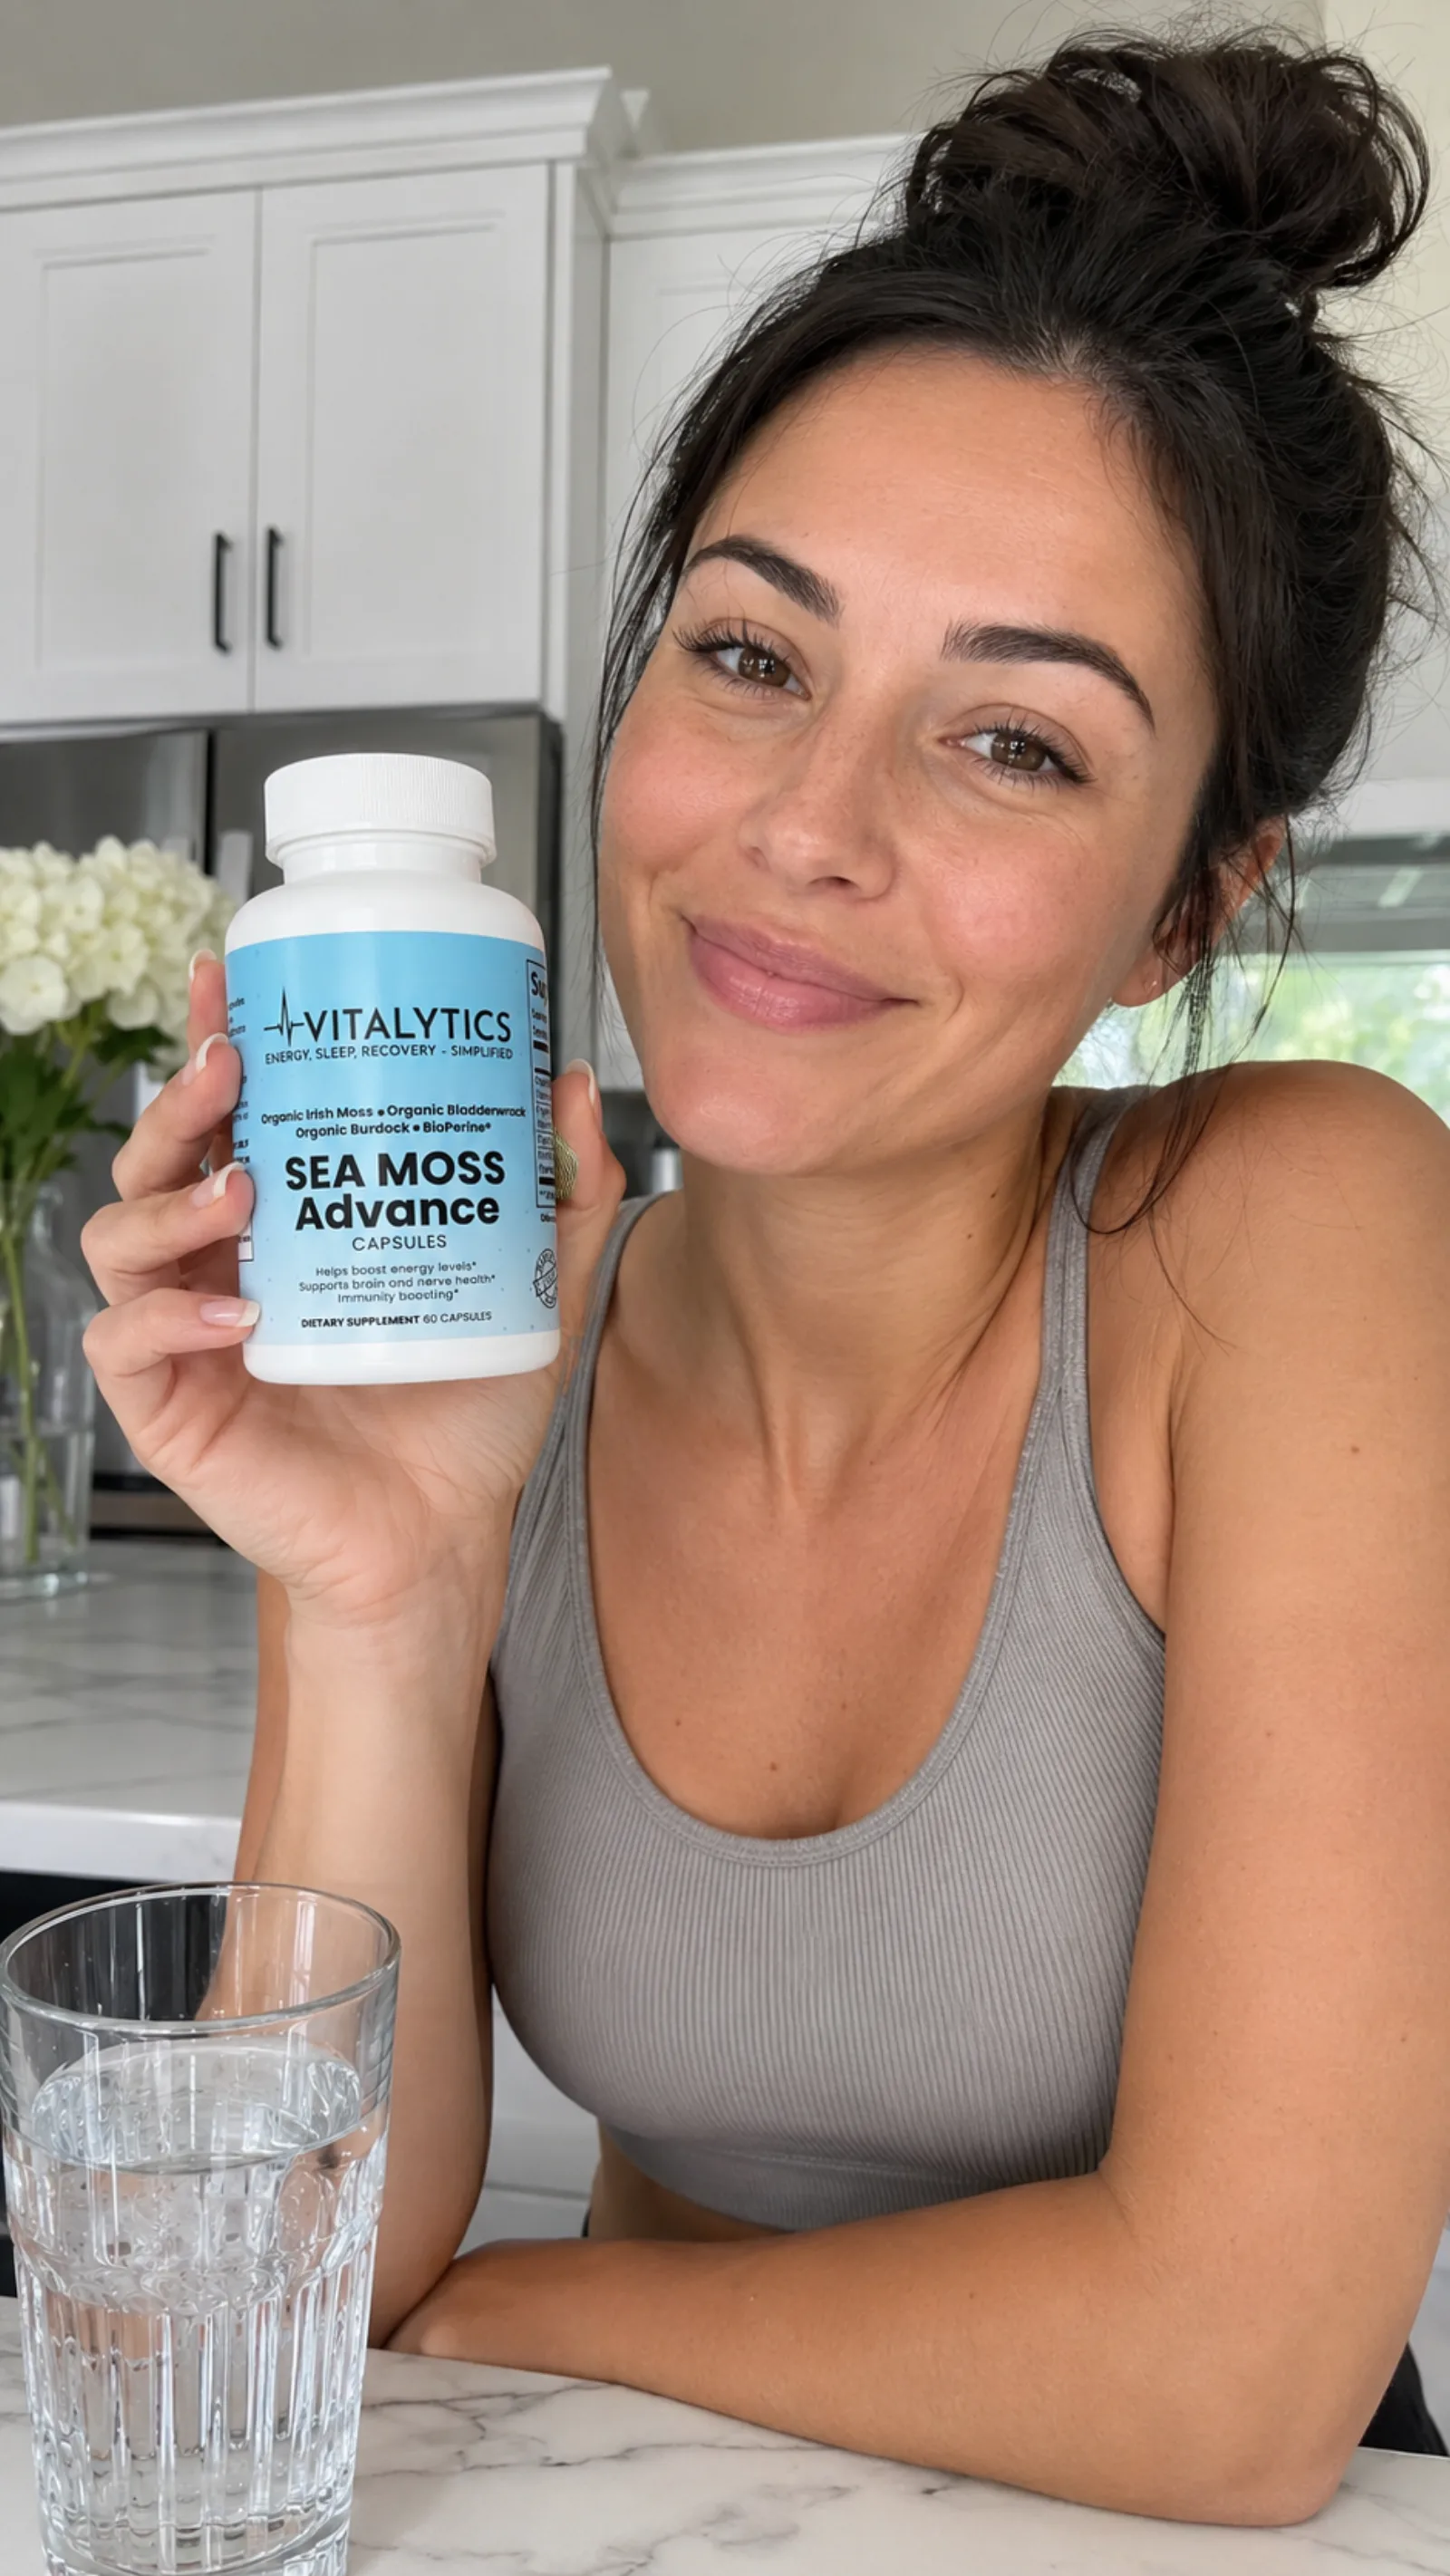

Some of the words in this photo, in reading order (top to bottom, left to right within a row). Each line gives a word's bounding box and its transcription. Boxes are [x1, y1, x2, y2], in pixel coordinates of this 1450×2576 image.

[304, 1007, 511, 1043] VITALYTICS
[266, 1049, 313, 1065] ENERGY,
[315, 1047, 358, 1060] SLEEP,
[362, 1044, 436, 1057] RECOVERY
[451, 1045, 514, 1060] SIMPLIFIED
[261, 1109, 304, 1126] Organic
[305, 1107, 334, 1120] Irish
[336, 1107, 373, 1118] Moss
[387, 1104, 444, 1120] Organic
[351, 1122, 411, 1136] Burdock
[285, 1154, 366, 1191] SEA
[378, 1150, 506, 1186] MOSS
[295, 1193, 500, 1230] Advance
[352, 1234, 447, 1251] CAPSULES
[315, 1267, 348, 1278] Helps
[351, 1265, 387, 1275] boost
[391, 1264, 435, 1276] energy
[299, 1281, 349, 1293] Supports
[417, 1277, 452, 1287] nerve
[338, 1292, 396, 1304] Immunity
[301, 1317, 344, 1328] DIETARY
[346, 1315, 420, 1327] SUPPLEMENT
[422, 1314, 437, 1324] 60
[440, 1311, 492, 1323] CAPSULES
